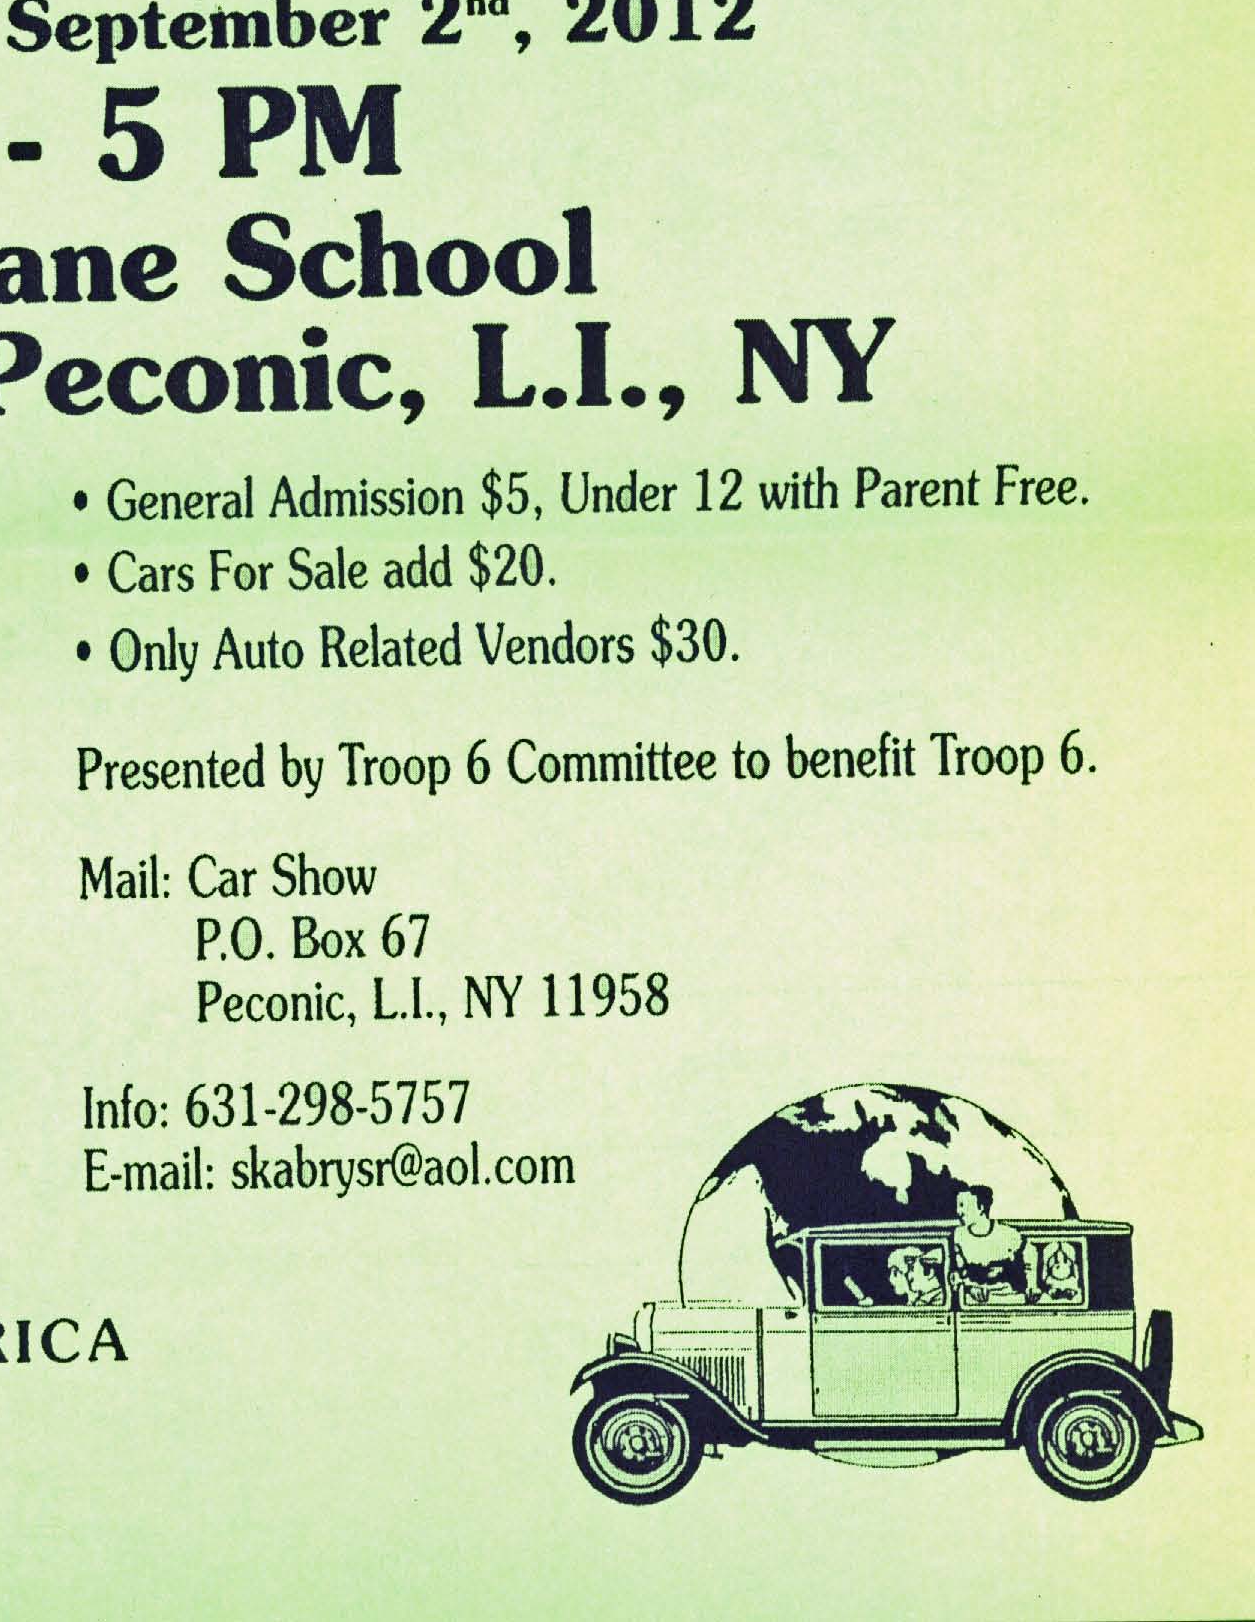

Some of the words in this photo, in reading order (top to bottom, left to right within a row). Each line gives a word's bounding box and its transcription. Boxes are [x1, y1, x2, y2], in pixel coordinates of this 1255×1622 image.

[6, 140, 43, 163] -
[96, 84, 166, 183] 5
[216, 82, 404, 180] PM
[223, 204, 599, 303] School
[471, 320, 686, 423] L.I.,
[732, 315, 898, 406] NY
[106, 473, 255, 523] General
[267, 473, 465, 519] Admission
[480, 466, 544, 522] $5,
[560, 467, 679, 516] Under
[694, 467, 744, 513] 12
[757, 464, 840, 512] with
[853, 465, 982, 510] Parent
[993, 462, 1090, 507] Free.
[106, 548, 196, 595] Cars
[208, 548, 275, 593] For
[287, 544, 370, 592] Sale
[382, 542, 454, 590] add
[467, 539, 557, 594] $20.
[108, 625, 200, 684] Only
[211, 625, 305, 672] Auto
[318, 620, 463, 669] Related
[473, 618, 636, 667] Vendors
[649, 612, 740, 670] $30.
[75, 740, 267, 793] Presented
[278, 740, 325, 800] by
[337, 740, 452, 797] Troop
[465, 737, 492, 786] 6
[506, 737, 718, 786] Committee
[730, 739, 772, 781] to
[784, 729, 917, 780] benefit
[928, 731, 1045, 787] Troop
[1059, 727, 1098, 776] 6.
[78, 852, 171, 902] Mail:
[187, 852, 259, 900] Car
[271, 850, 379, 899] Show
[195, 914, 276, 963] P.O.
[291, 914, 367, 960] Box
[380, 911, 431, 960] 67
[196, 979, 357, 1029] Peconic,
[372, 975, 448, 1028] L.I.,
[463, 974, 524, 1020] NY
[541, 970, 670, 1019] 11958
[82, 1082, 169, 1131] Info:
[184, 1078, 471, 1130] 631-298-5757
[82, 1144, 215, 1194] E-mail:
[230, 1139, 577, 1200] skabrysr@aol.com
